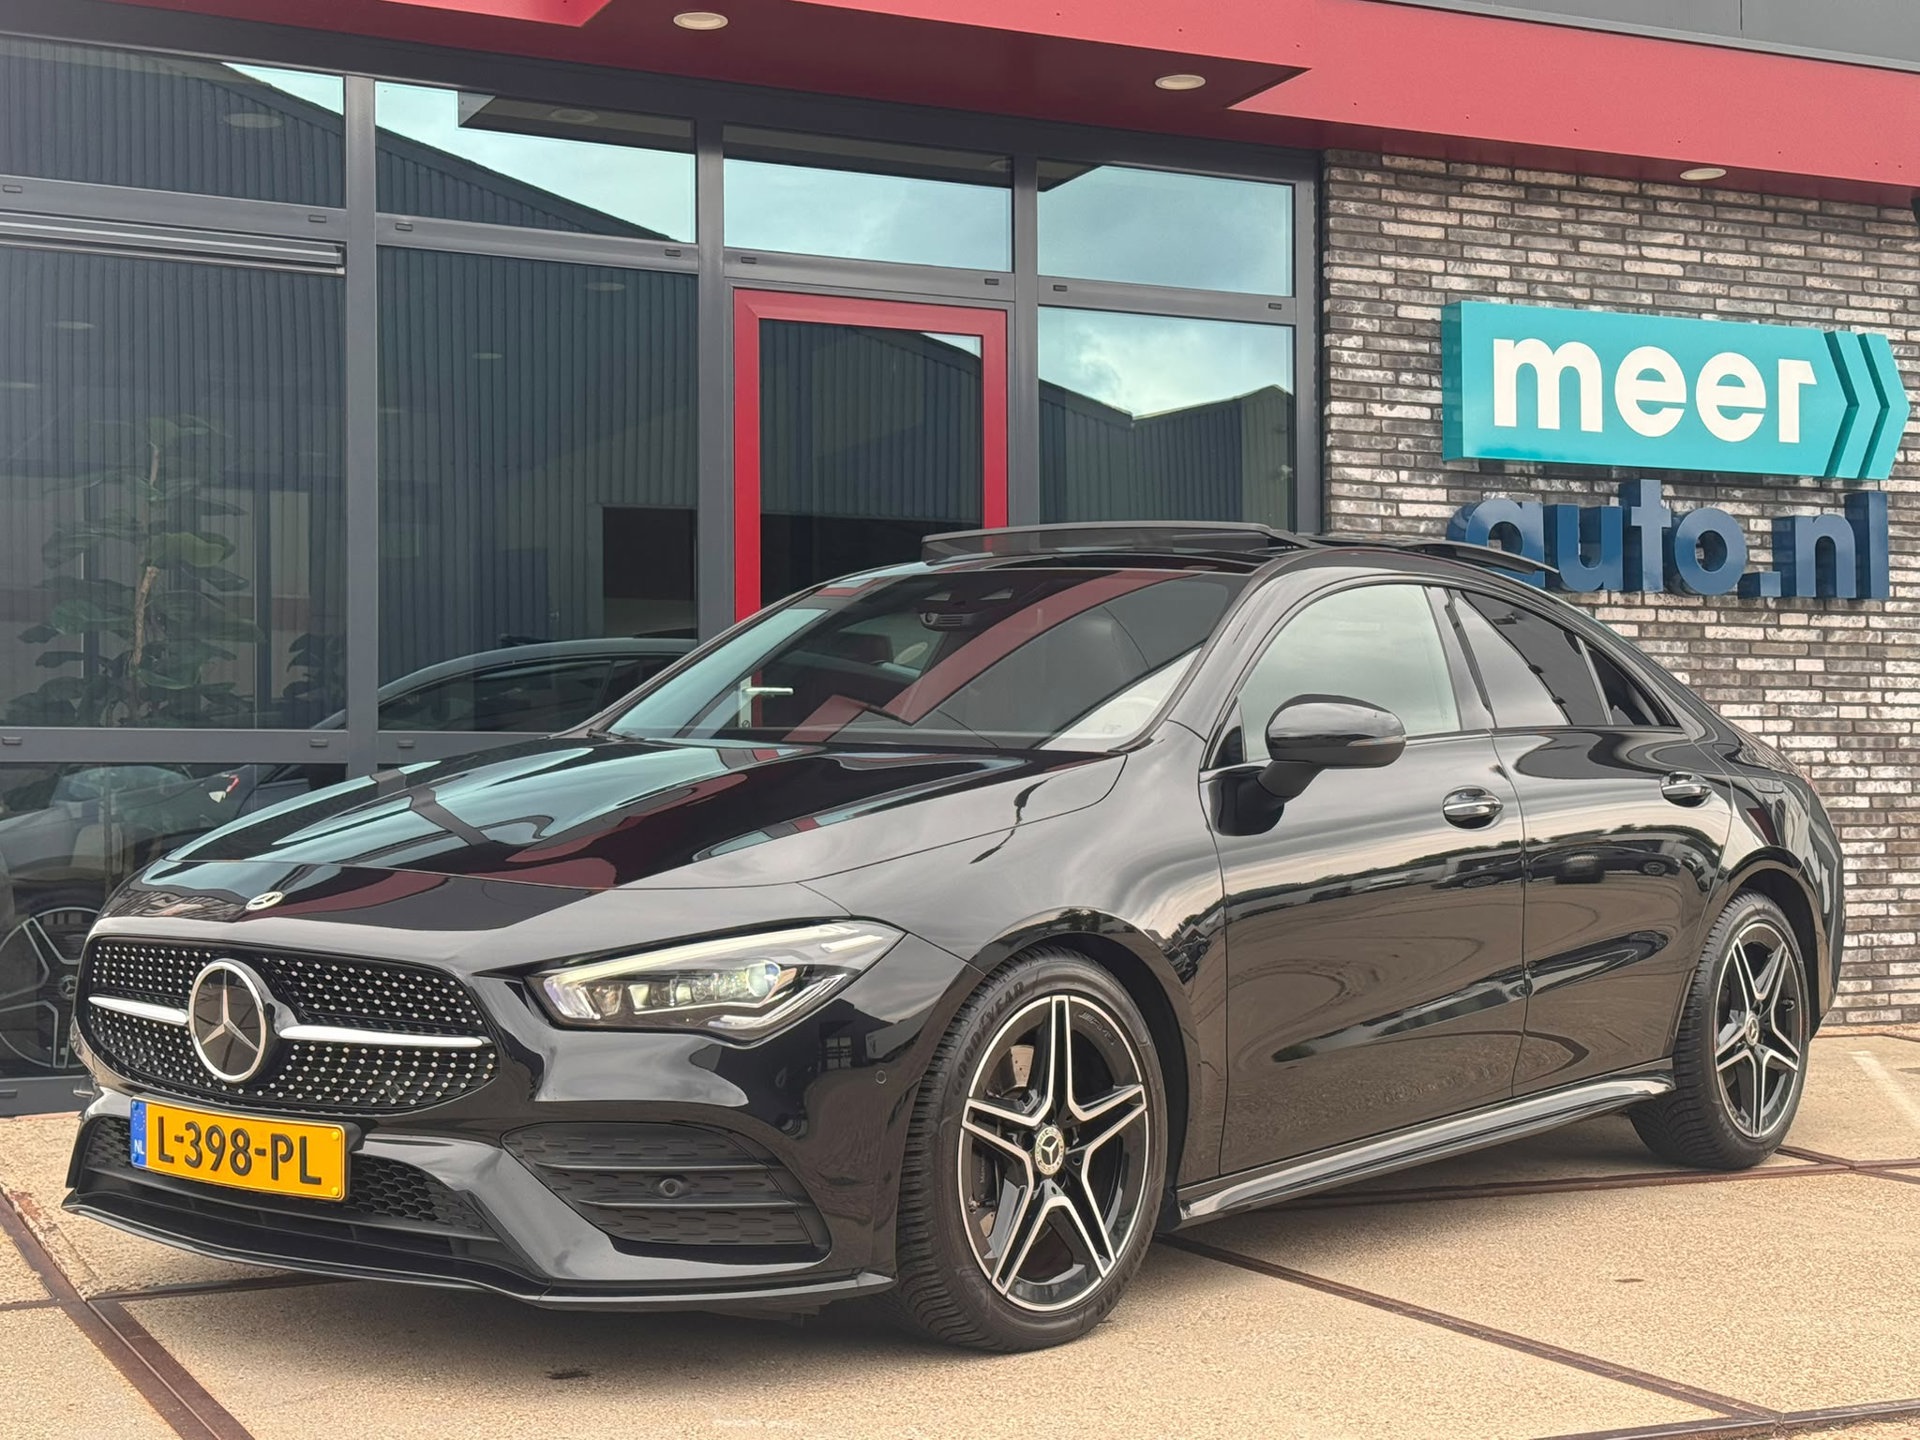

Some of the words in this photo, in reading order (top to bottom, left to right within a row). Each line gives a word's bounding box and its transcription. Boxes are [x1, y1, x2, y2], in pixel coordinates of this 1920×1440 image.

[1493, 337, 1817, 443] meer
[1449, 479, 1889, 599] auto.nl
[133, 1138, 146, 1156] NL
[157, 1115, 322, 1186] L-398-PL
